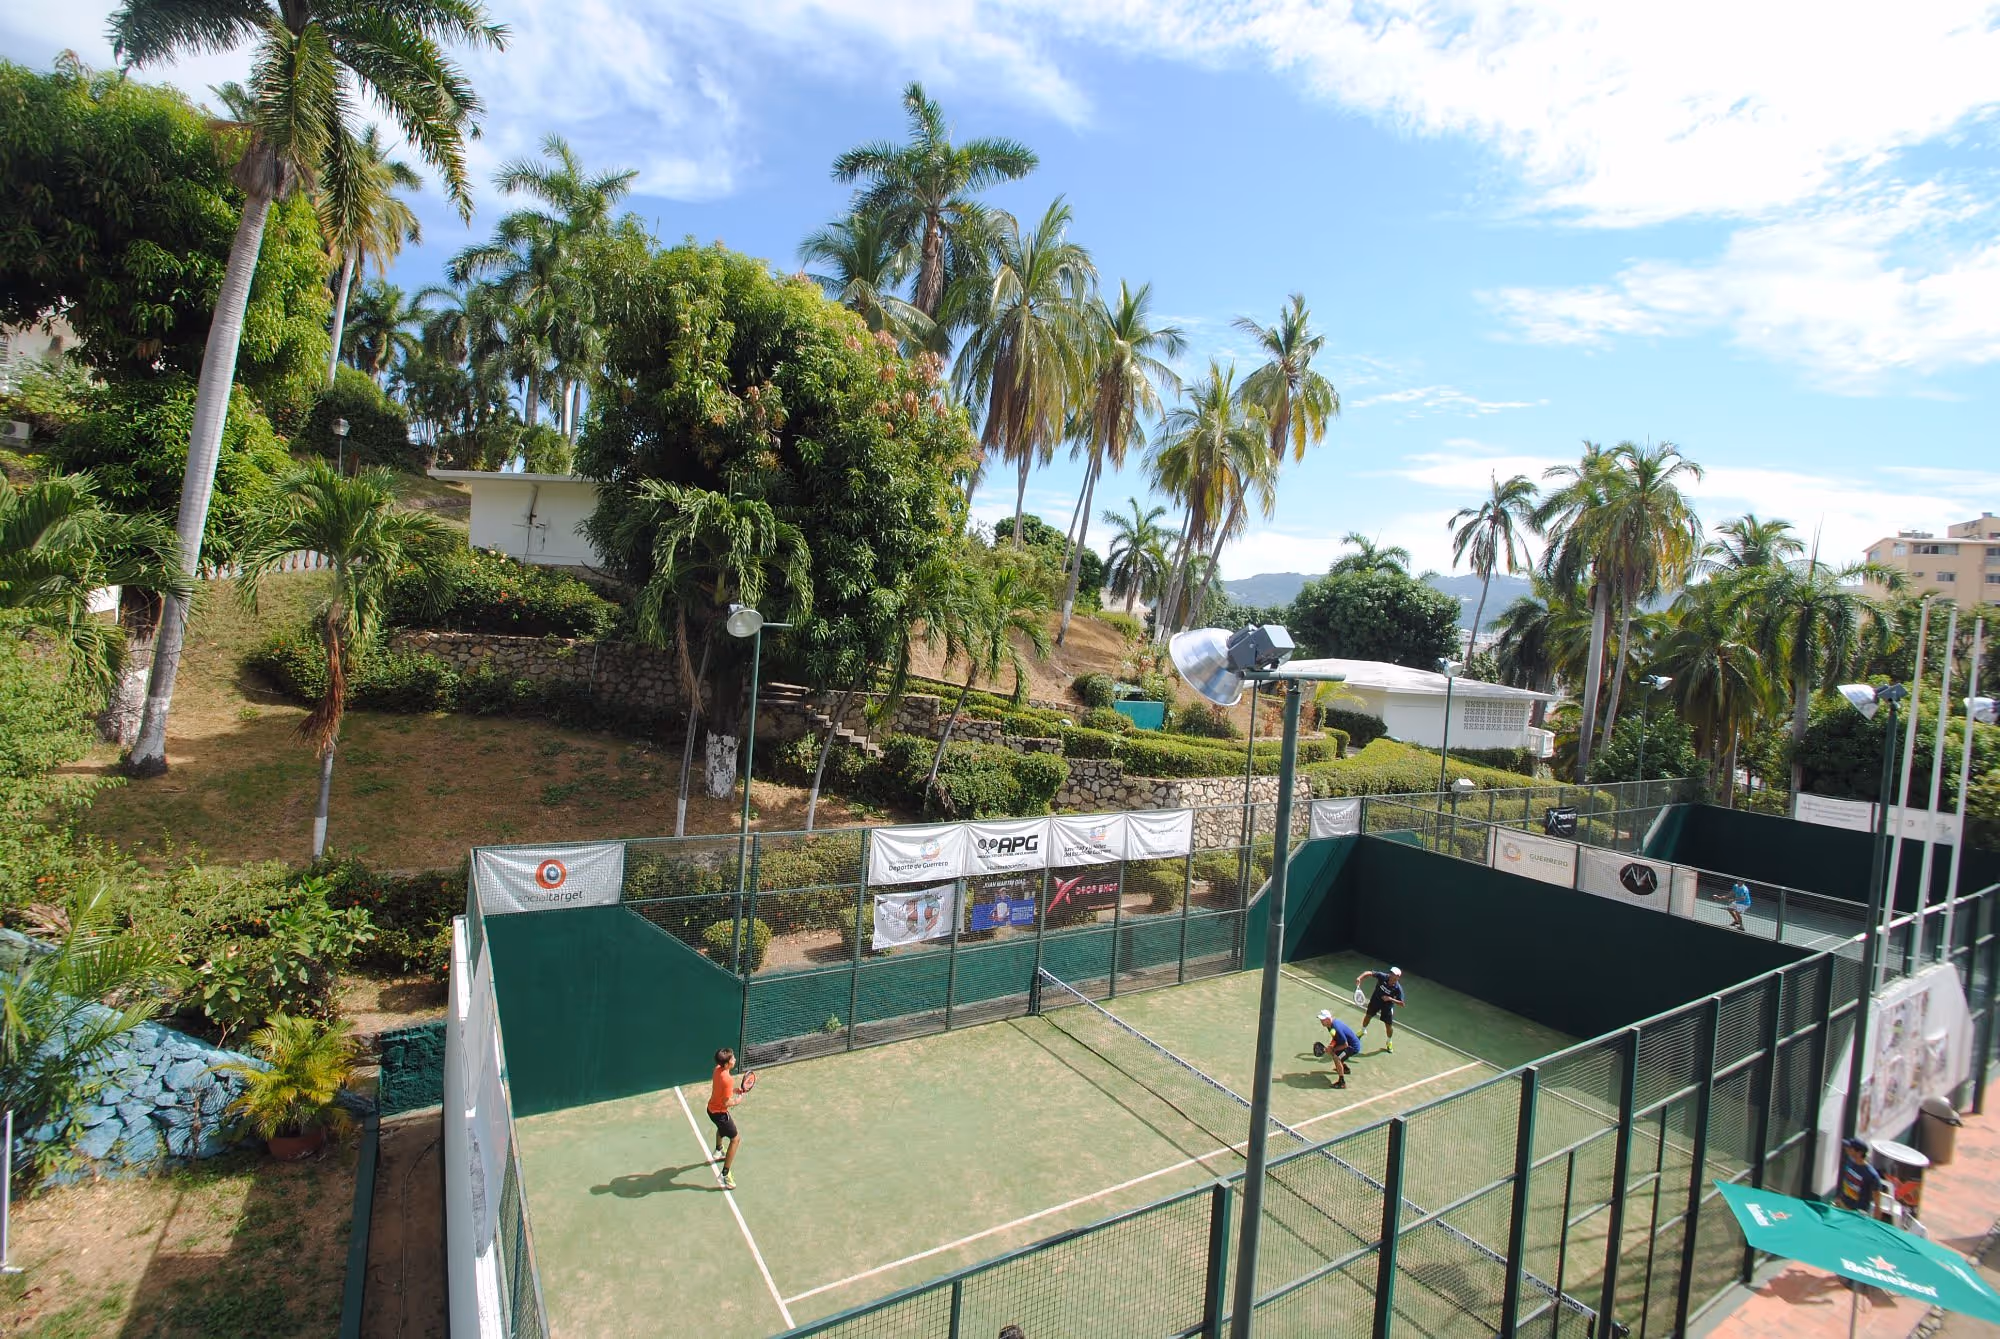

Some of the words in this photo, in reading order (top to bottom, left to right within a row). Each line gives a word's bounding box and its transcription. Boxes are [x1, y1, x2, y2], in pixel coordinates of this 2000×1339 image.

[998, 834, 1038, 853] APG
[888, 864, 913, 872] Deporte
[922, 861, 949, 869] Guerrero
[1529, 853, 1569, 868] GUERRERO
[1075, 885, 1097, 895] DROP
[1289, 1130, 1304, 1143] SHOT
[1840, 1257, 1939, 1298] Heineken
[1560, 1295, 1585, 1313] SHOT
